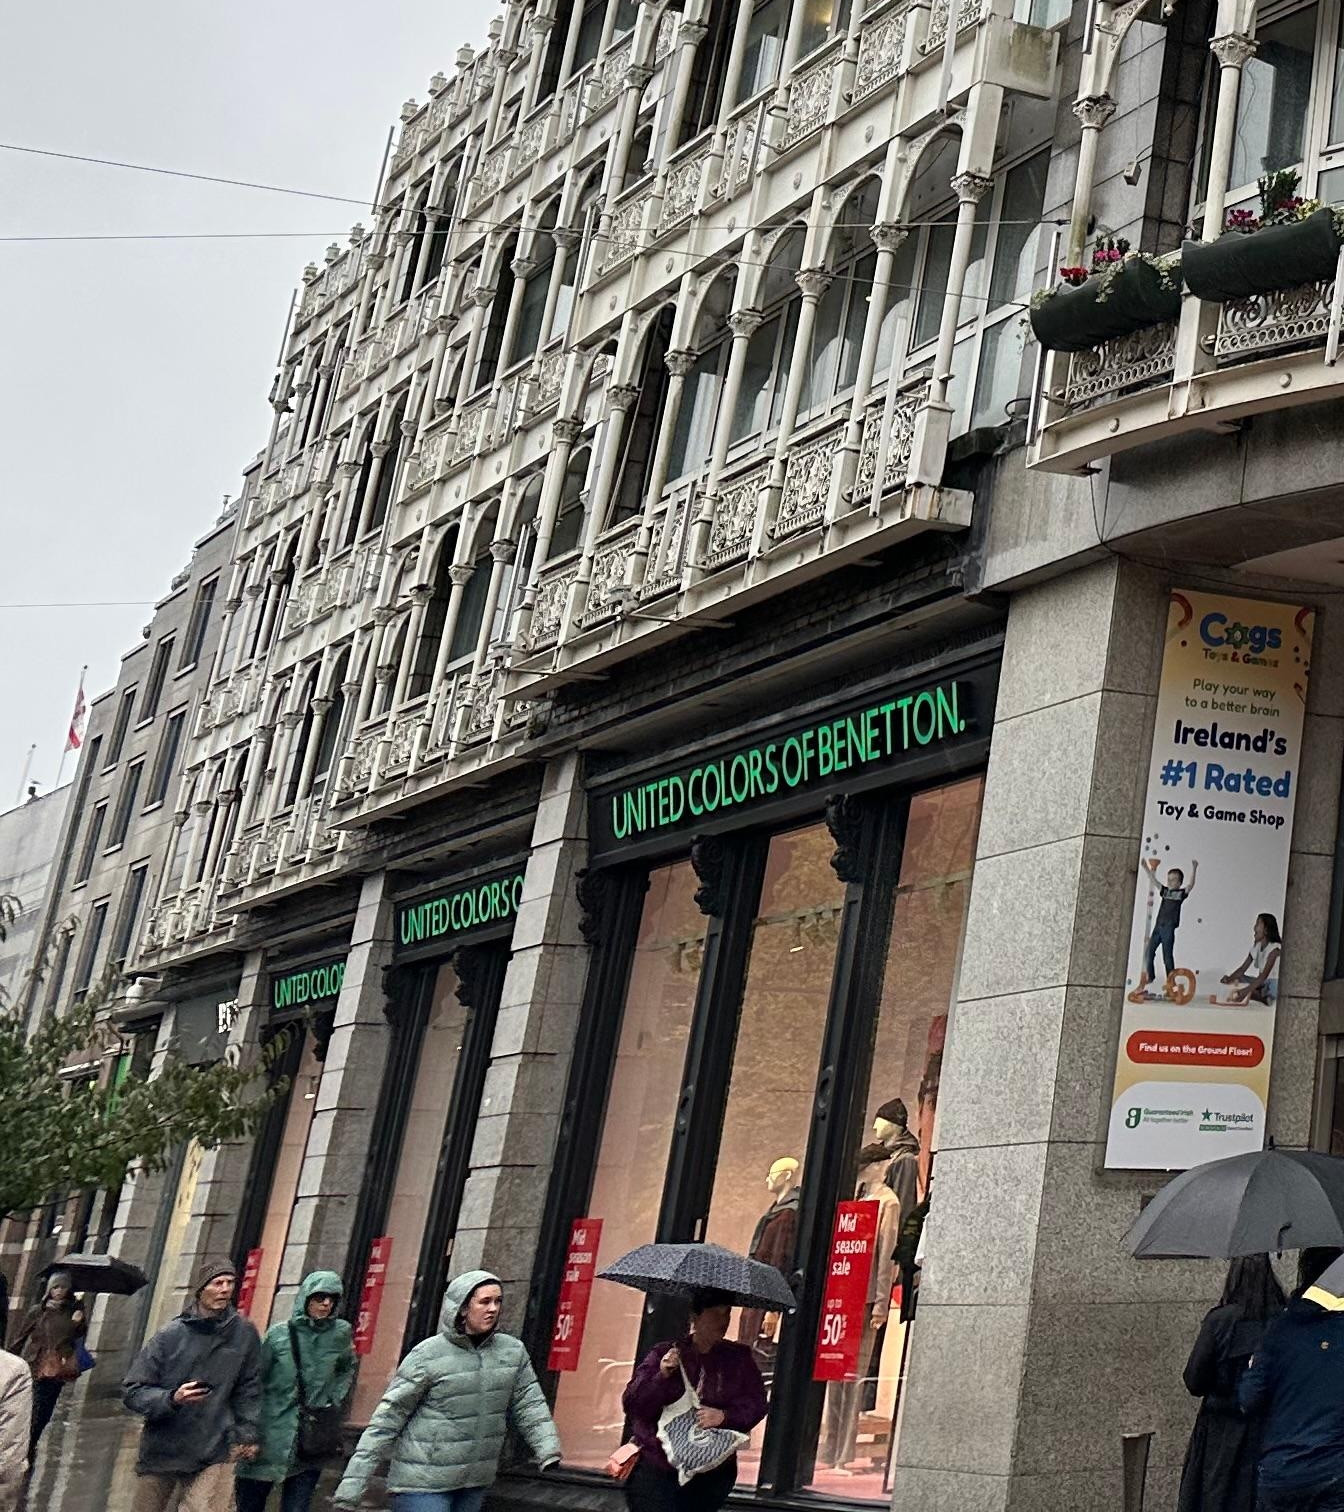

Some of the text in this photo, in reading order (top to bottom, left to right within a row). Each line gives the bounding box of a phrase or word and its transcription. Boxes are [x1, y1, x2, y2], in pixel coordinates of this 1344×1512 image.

[1200, 612, 1282, 654] Cogs
[1231, 652, 1240, 663] &
[1193, 678, 1276, 701] Play your way
[1185, 696, 1280, 717] to a better brain
[1174, 719, 1287, 755] Ireland's
[612, 775, 684, 839] UNITED
[688, 744, 779, 816] COLORS
[782, 730, 815, 787] OF
[1159, 759, 1291, 798] #1 Rated
[1157, 801, 1285, 829] Toy & Game Shop
[401, 898, 449, 944] UNITED
[451, 879, 510, 930] COLORS
[275, 973, 309, 1008] UNITED
[1139, 1043, 1253, 1056] Find us on the Ground Floor!
[1215, 1112, 1253, 1124] Trustpilot
[838, 1213, 858, 1233] Mid
[835, 1240, 867, 1254] season
[832, 1256, 851, 1275] sale
